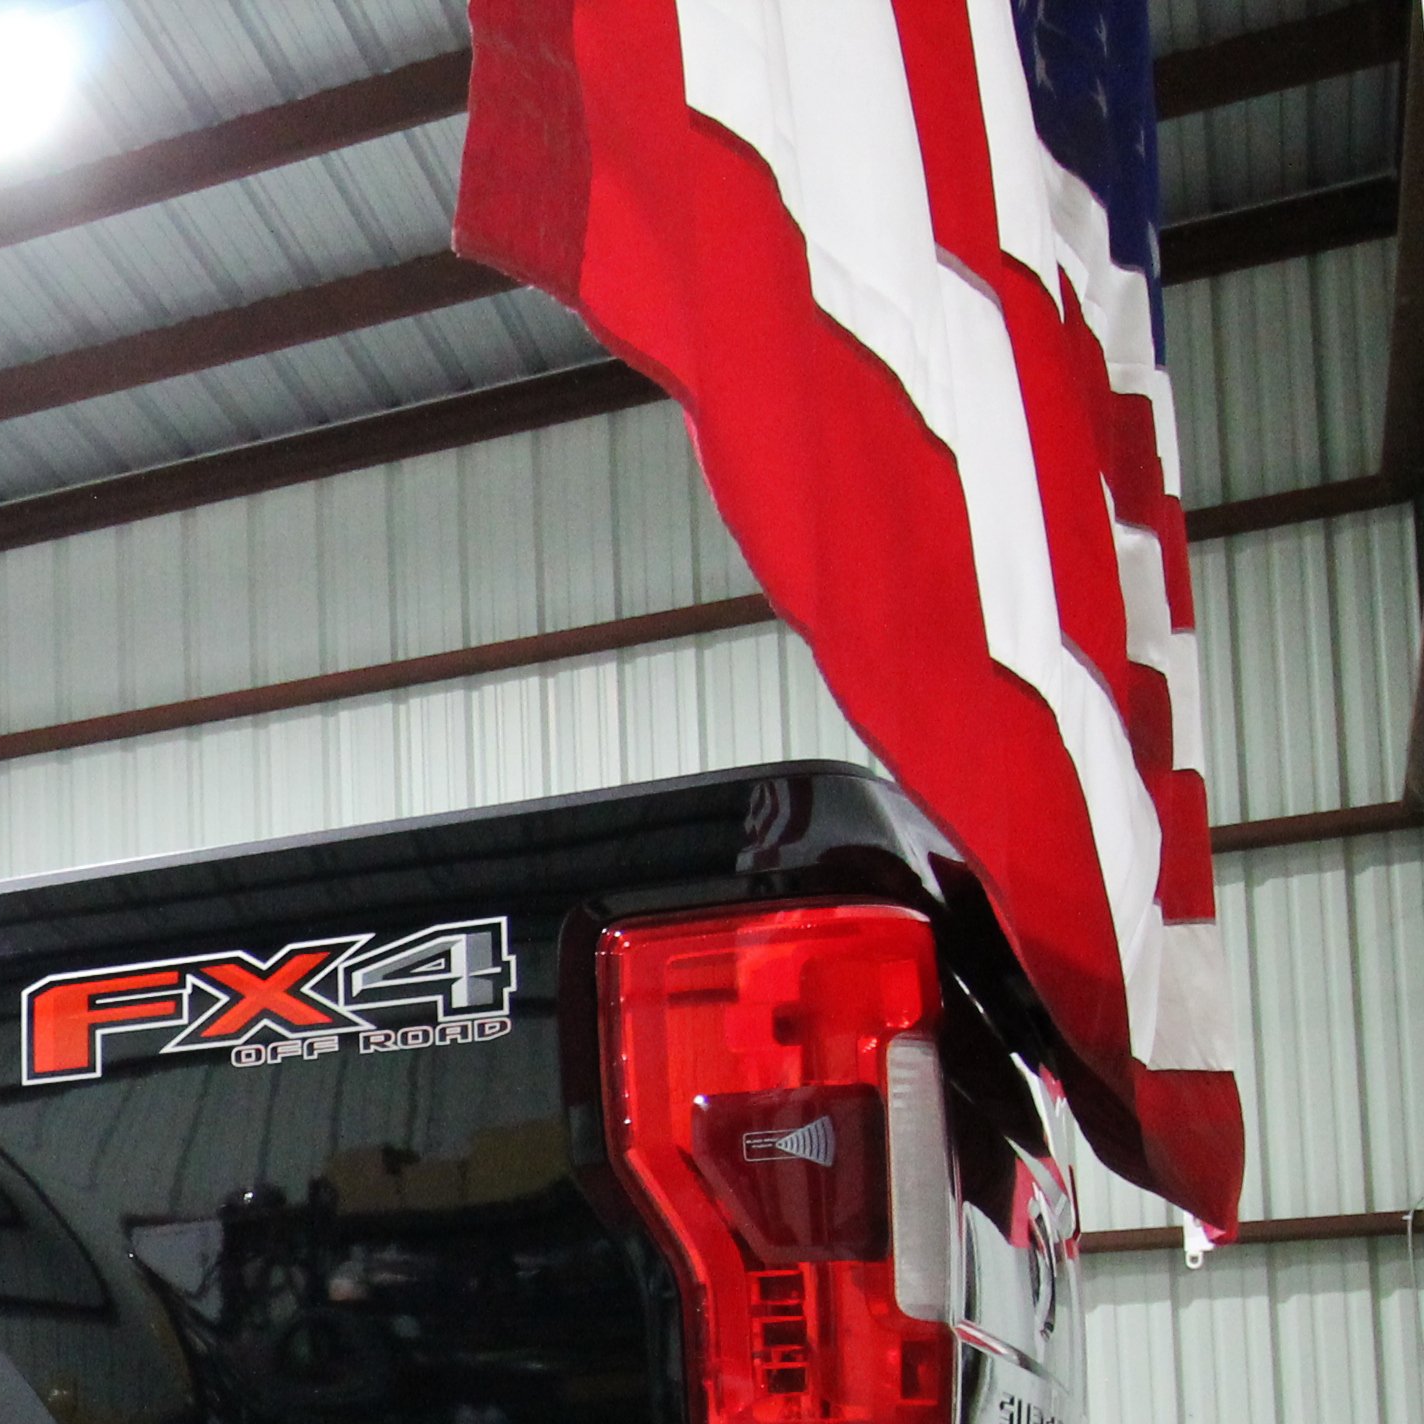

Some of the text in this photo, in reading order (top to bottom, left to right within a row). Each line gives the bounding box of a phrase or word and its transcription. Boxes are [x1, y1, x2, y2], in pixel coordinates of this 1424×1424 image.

[22, 916, 517, 1086] FX4
[231, 1017, 511, 1068] OFF ROAD
